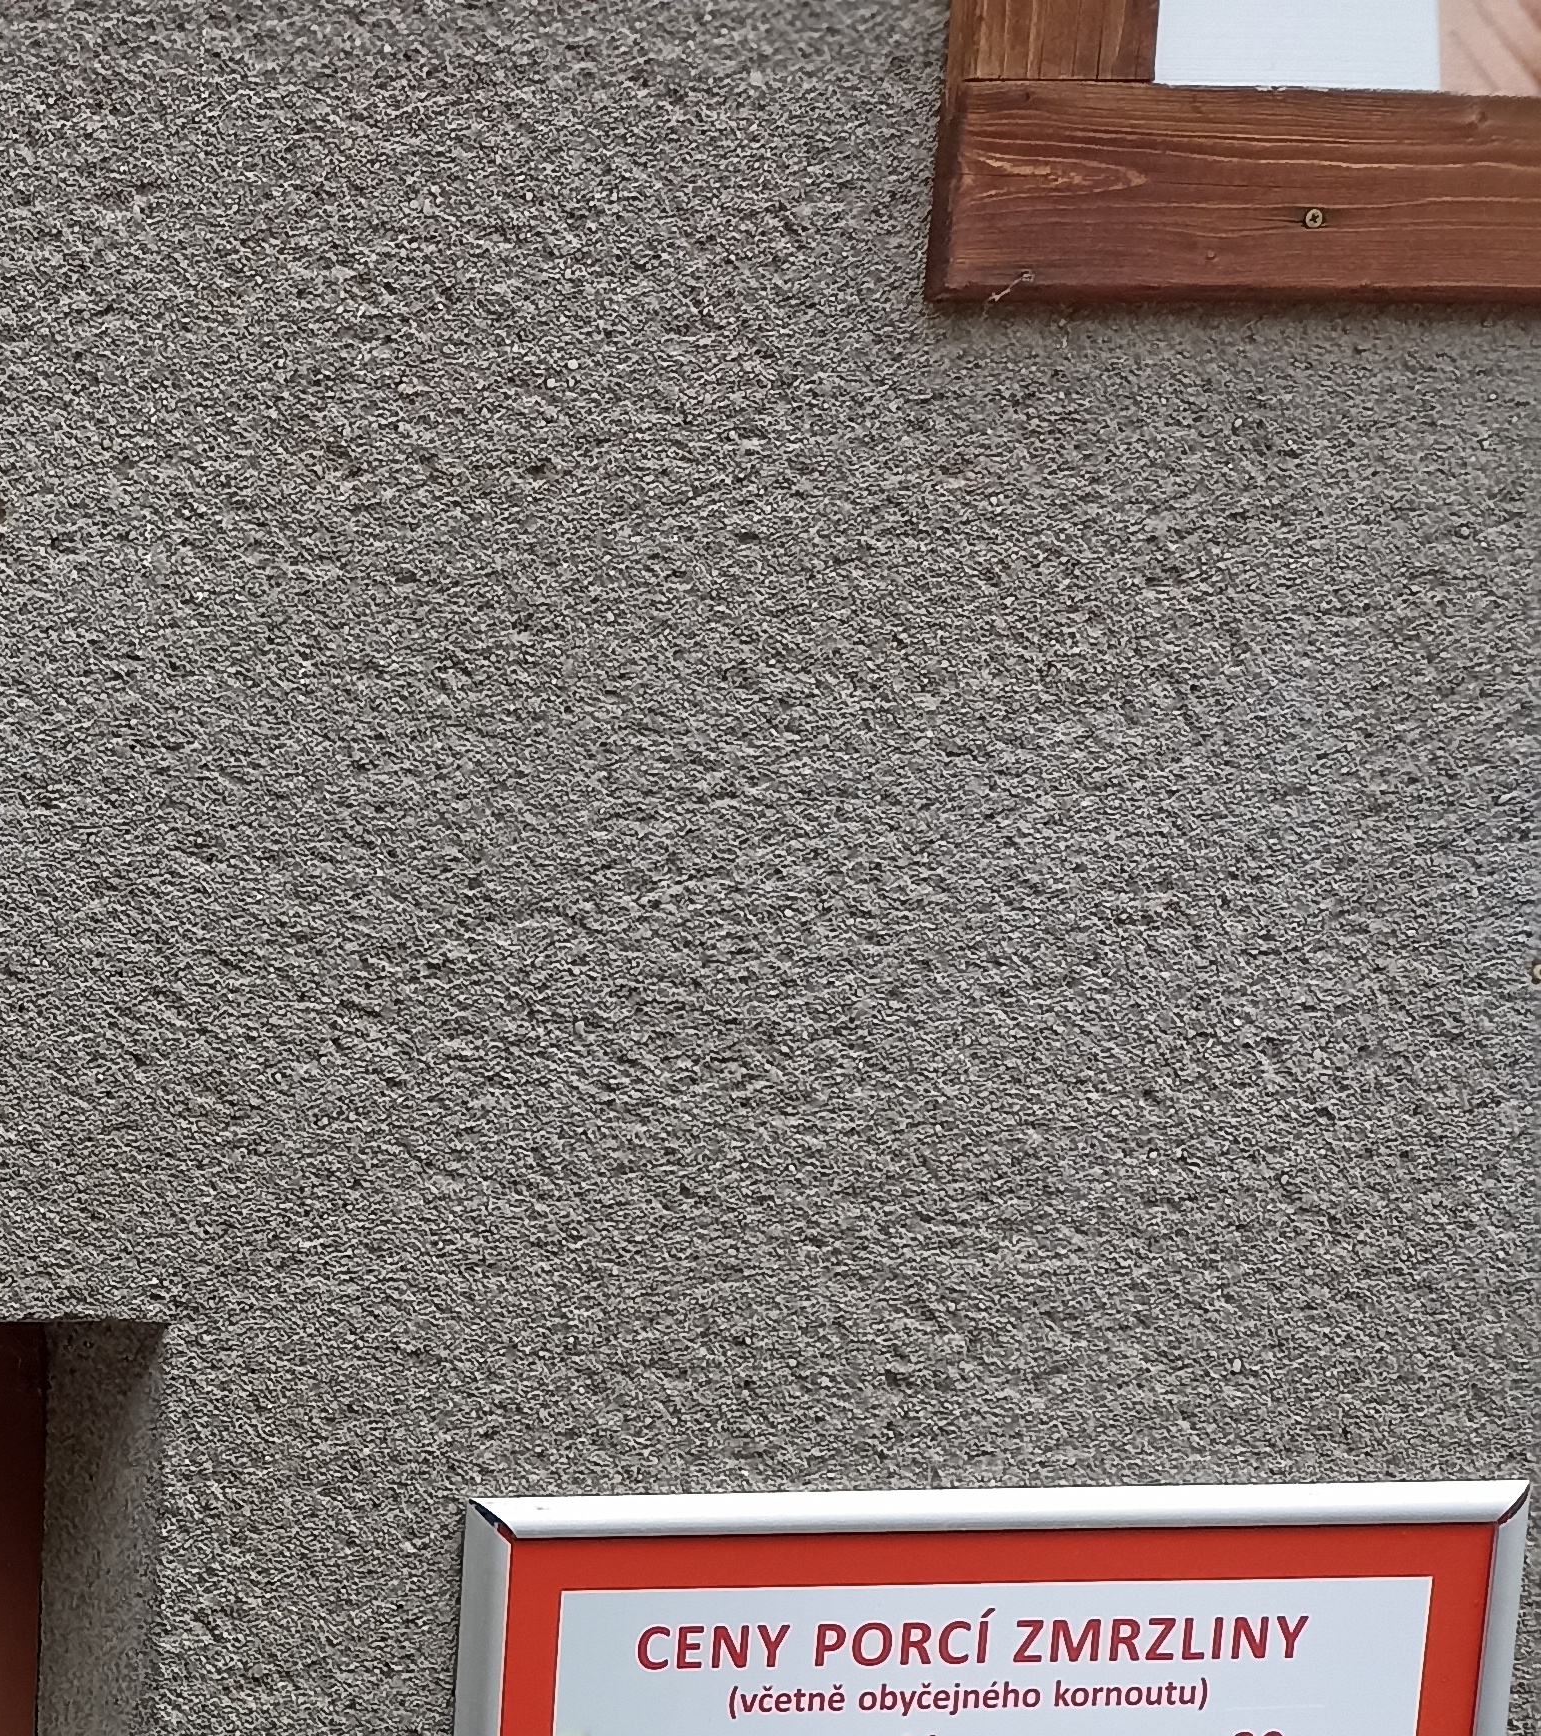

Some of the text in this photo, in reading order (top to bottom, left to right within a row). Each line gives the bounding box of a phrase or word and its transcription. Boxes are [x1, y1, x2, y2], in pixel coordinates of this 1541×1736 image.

[638, 1608, 1309, 1670] CENY PORCÍ ZMRZLINY
[729, 1677, 1207, 1719] (včetně obyčejného kornoutu)
